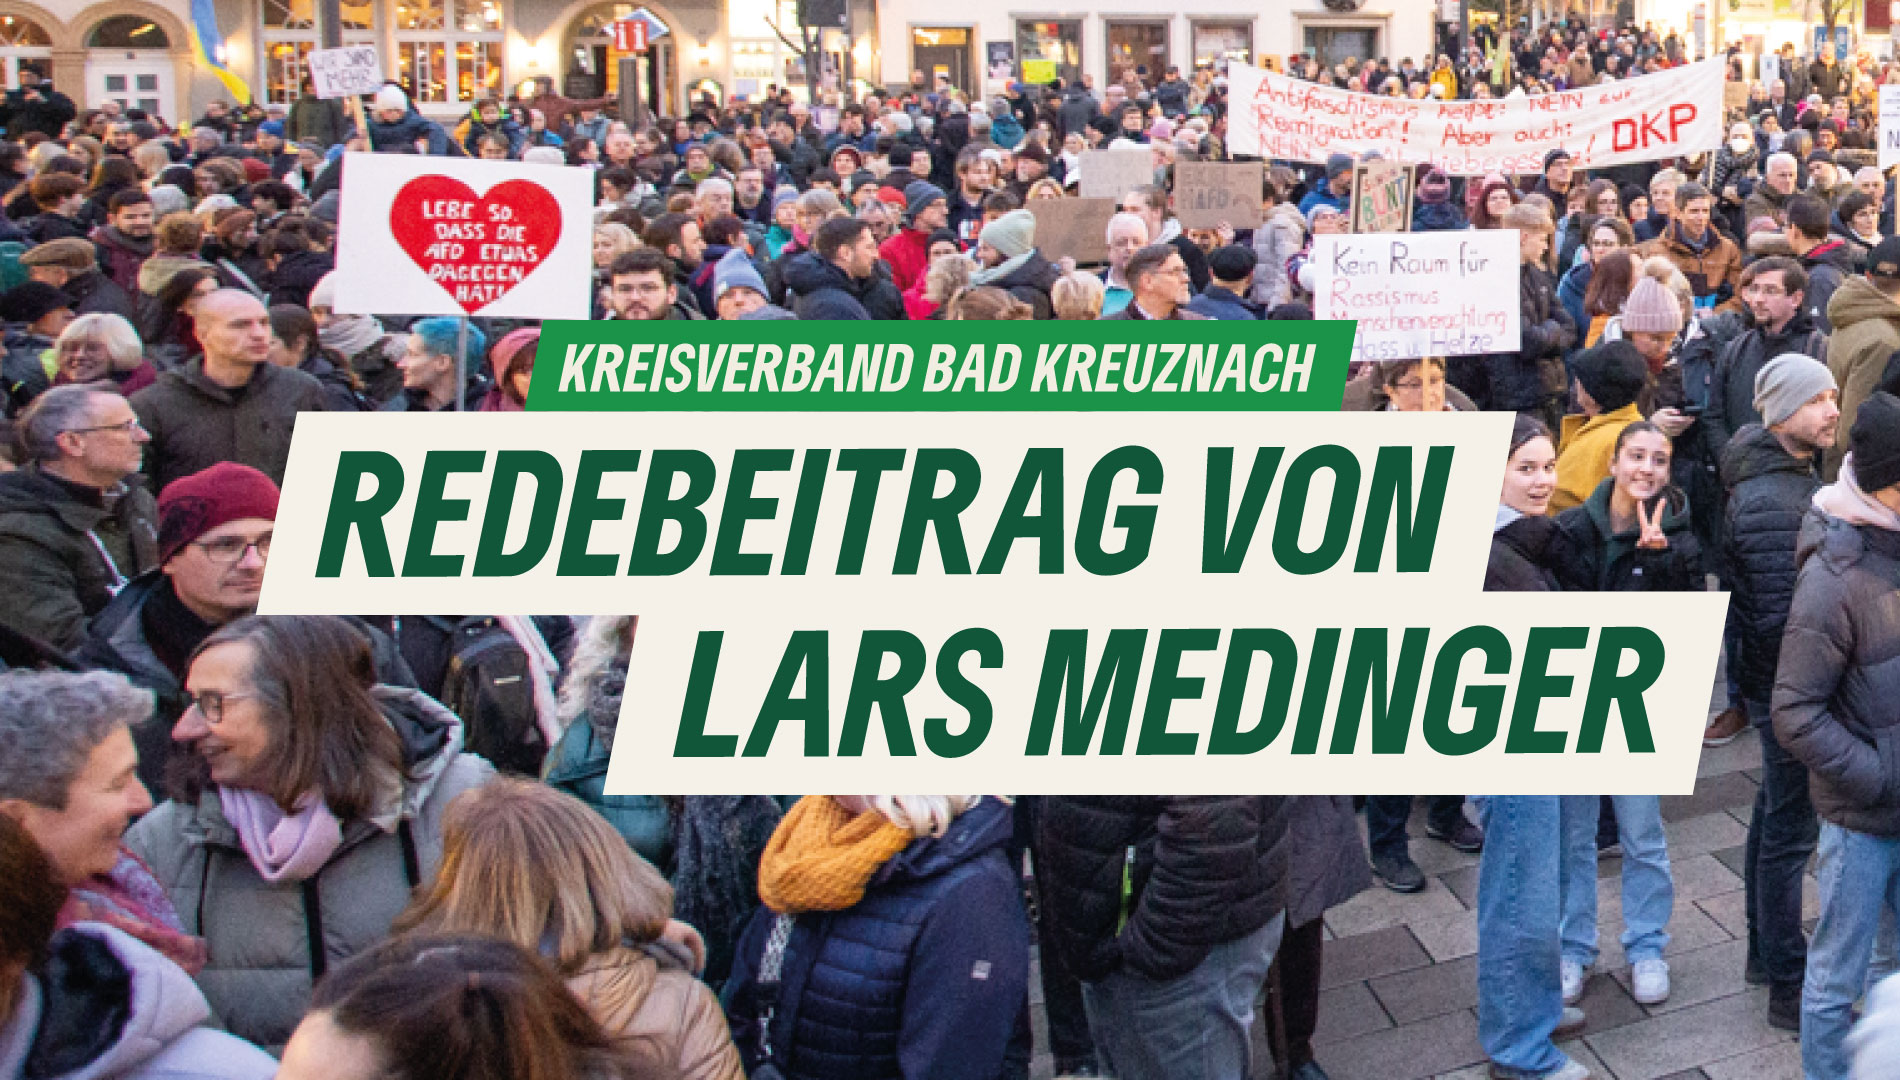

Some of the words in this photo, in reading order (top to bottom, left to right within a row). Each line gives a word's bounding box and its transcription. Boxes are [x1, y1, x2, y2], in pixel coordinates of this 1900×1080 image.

[1255, 76, 1419, 119] Antifaschismus
[1529, 92, 1584, 113] NEIN
[1440, 123, 1495, 147] Aber
[1611, 103, 1698, 153] DKP
[422, 199, 475, 219] LEBE
[1362, 175, 1407, 225] BUNT
[434, 222, 485, 240] DASS
[496, 224, 527, 242] DIE
[479, 243, 539, 263] ETWAS
[1332, 241, 1380, 277] Kein
[1389, 241, 1450, 275] Raum
[1460, 241, 1489, 277] für
[428, 263, 525, 282] DAGEGEN
[1329, 277, 1440, 307] Rassismus
